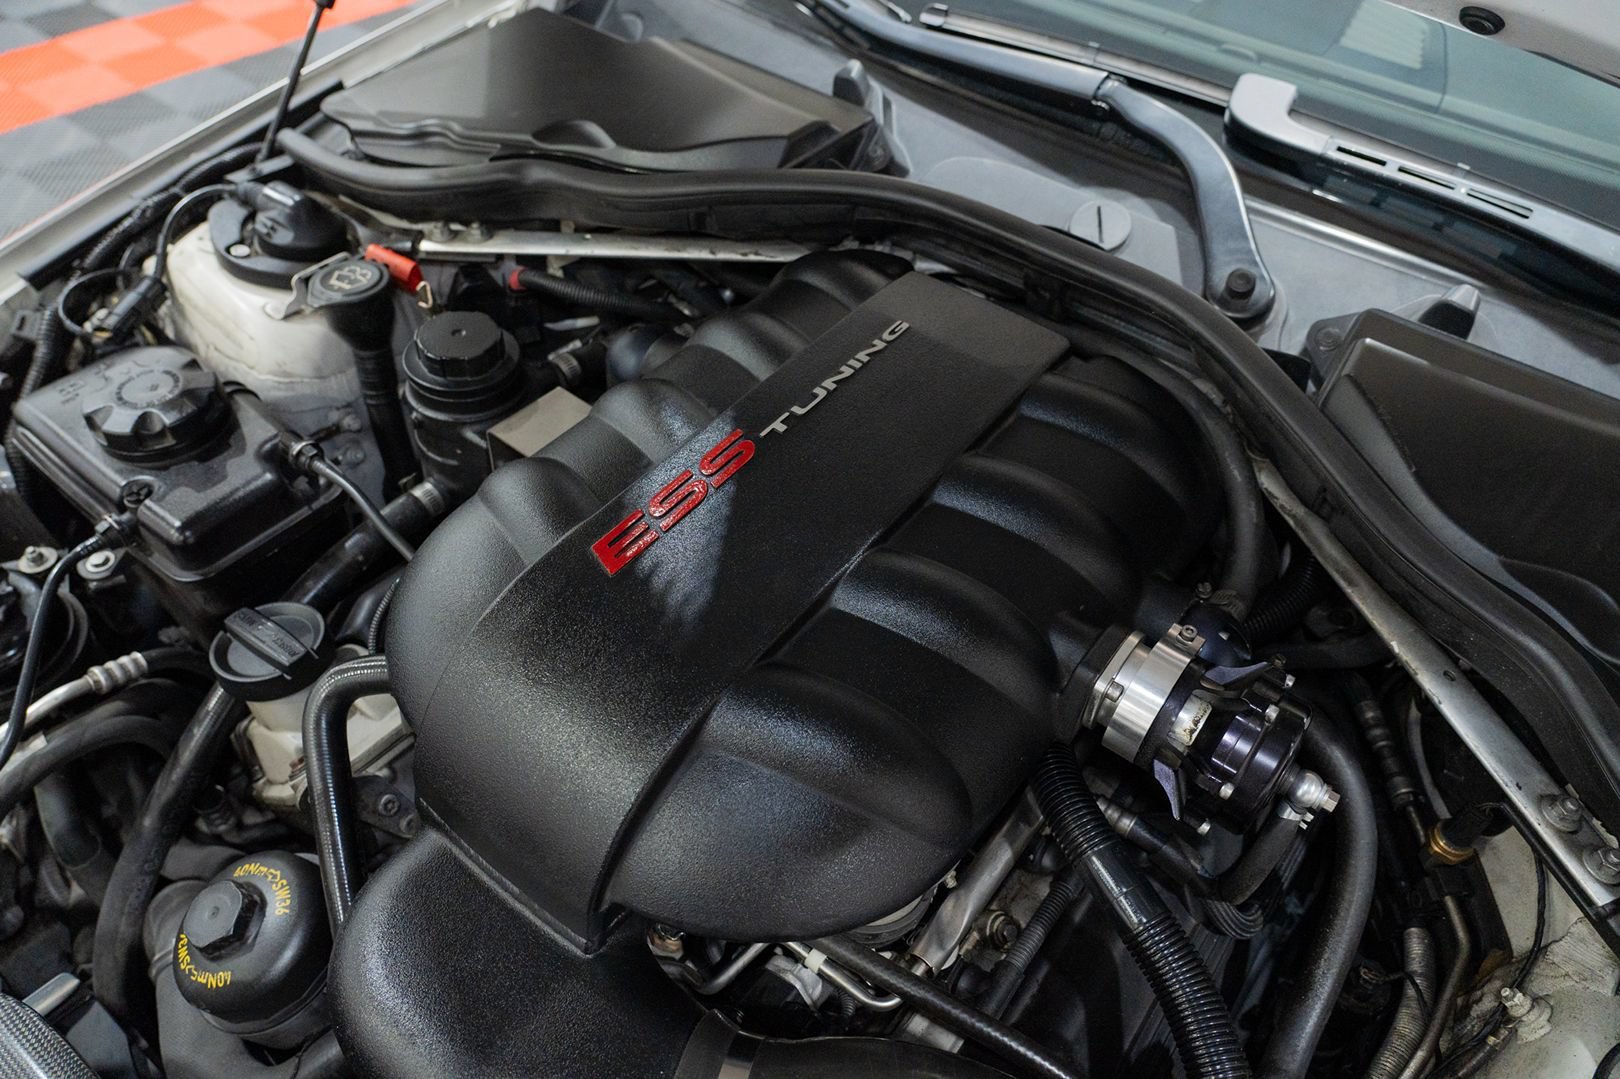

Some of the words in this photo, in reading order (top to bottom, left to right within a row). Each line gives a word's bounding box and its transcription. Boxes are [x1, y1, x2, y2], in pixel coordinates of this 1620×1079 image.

[591, 428, 756, 577] ESS
[760, 320, 910, 438] TUNING
[272, 879, 291, 916] SW36
[177, 933, 191, 970] SW3
